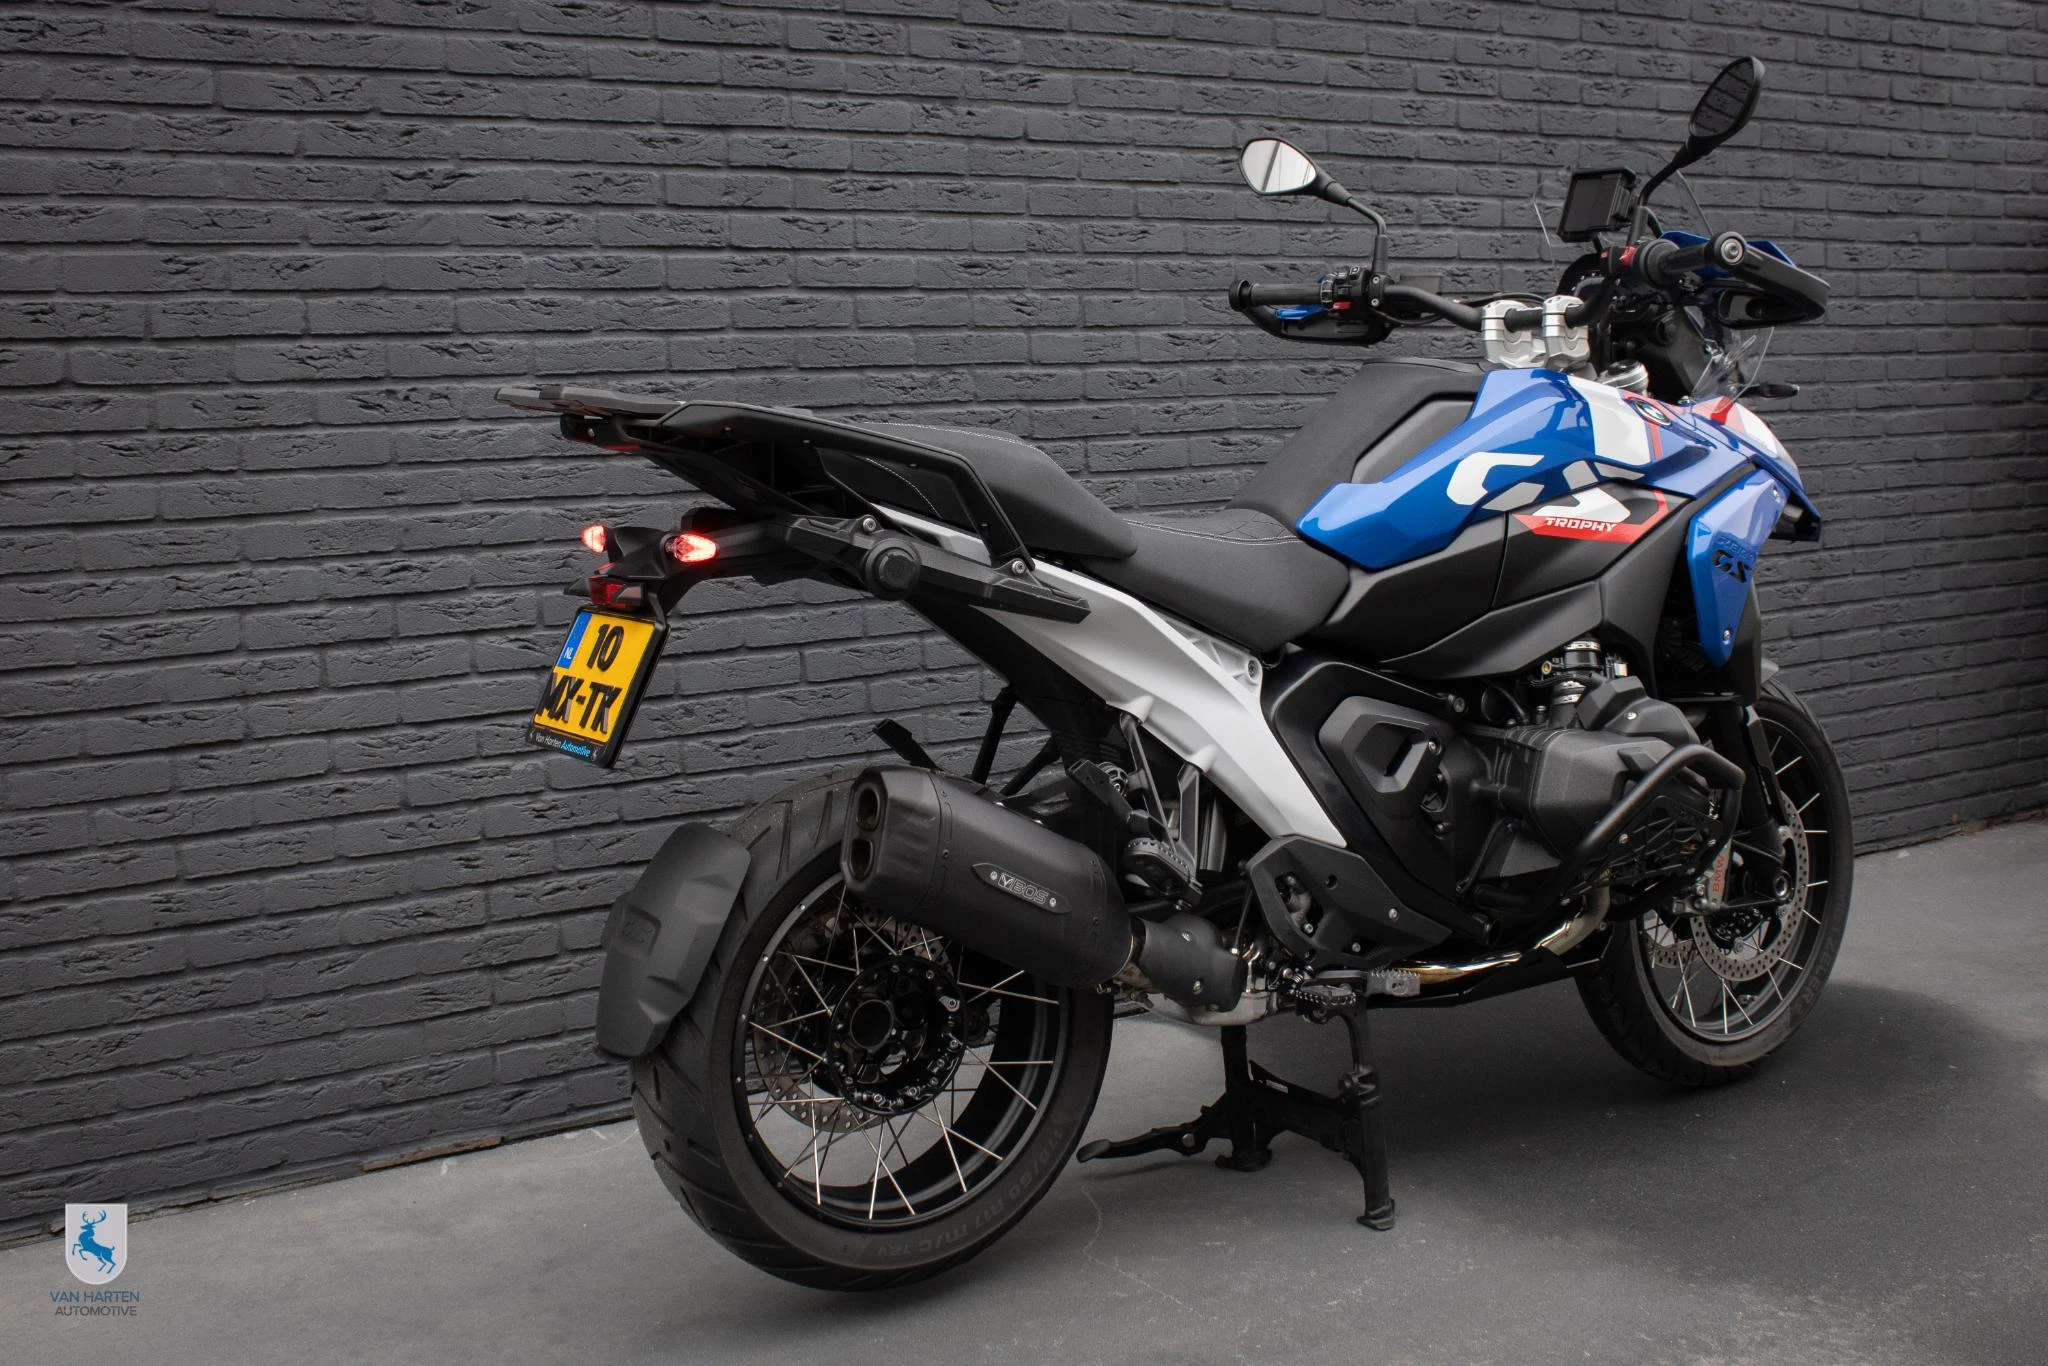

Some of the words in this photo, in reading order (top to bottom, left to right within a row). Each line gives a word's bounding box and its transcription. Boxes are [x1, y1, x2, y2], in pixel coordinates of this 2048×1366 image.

[1545, 517, 1617, 532] TROPHY
[564, 647, 573, 660] NL
[586, 623, 625, 672] 10
[561, 740, 591, 757] Automotive
[1712, 856, 1725, 892] BMW
